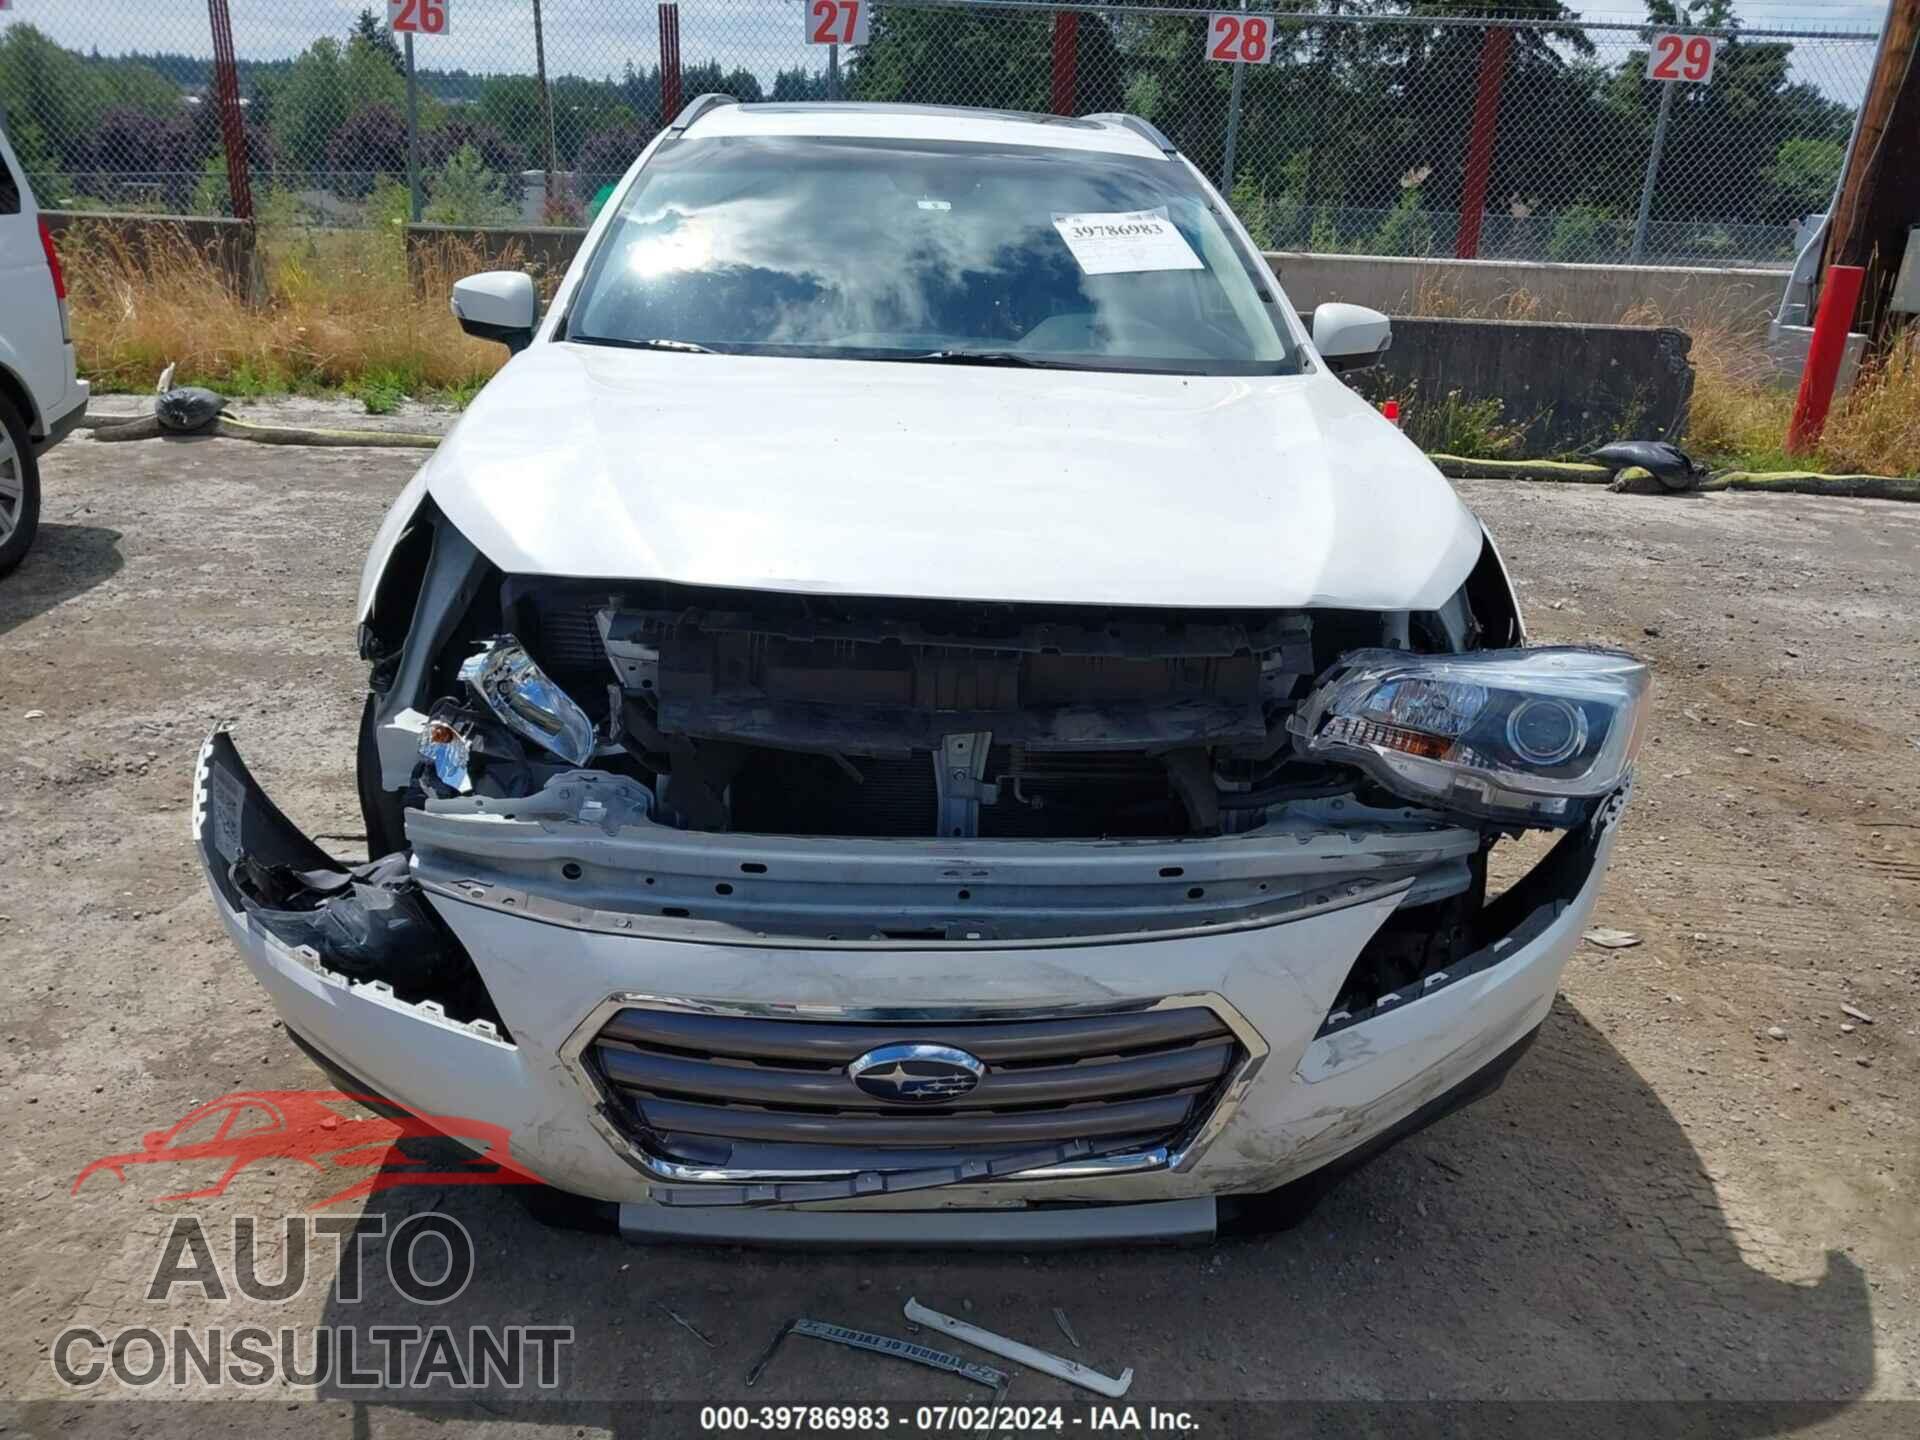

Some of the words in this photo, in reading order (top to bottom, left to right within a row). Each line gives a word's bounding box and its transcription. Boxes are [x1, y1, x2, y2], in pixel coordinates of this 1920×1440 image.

[392, 0, 444, 32] 26
[814, 0, 858, 43] 27
[1213, 16, 1266, 61] 28
[1653, 35, 1711, 80] 29
[1071, 222, 1164, 237] 39786983
